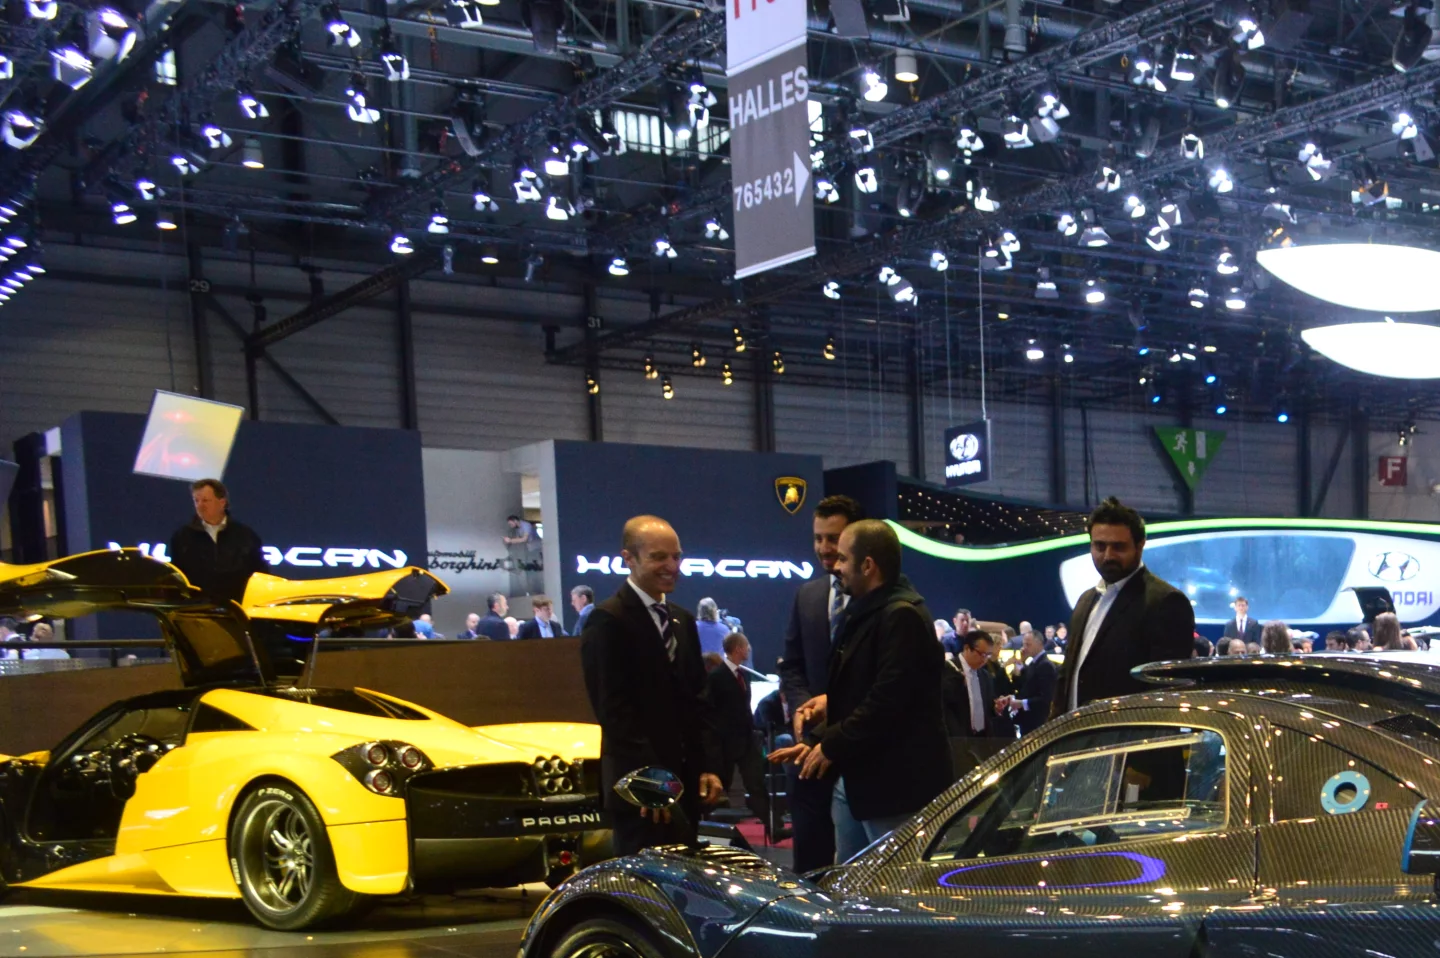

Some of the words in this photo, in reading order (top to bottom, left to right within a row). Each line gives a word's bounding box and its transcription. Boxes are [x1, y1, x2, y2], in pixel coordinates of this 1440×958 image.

[729, 65, 809, 129] HALLES
[734, 167, 794, 211] 765432
[190, 279, 210, 292] 29
[587, 316, 601, 328] 31
[576, 554, 814, 579] HUACAN
[522, 812, 601, 828] PAGANI
